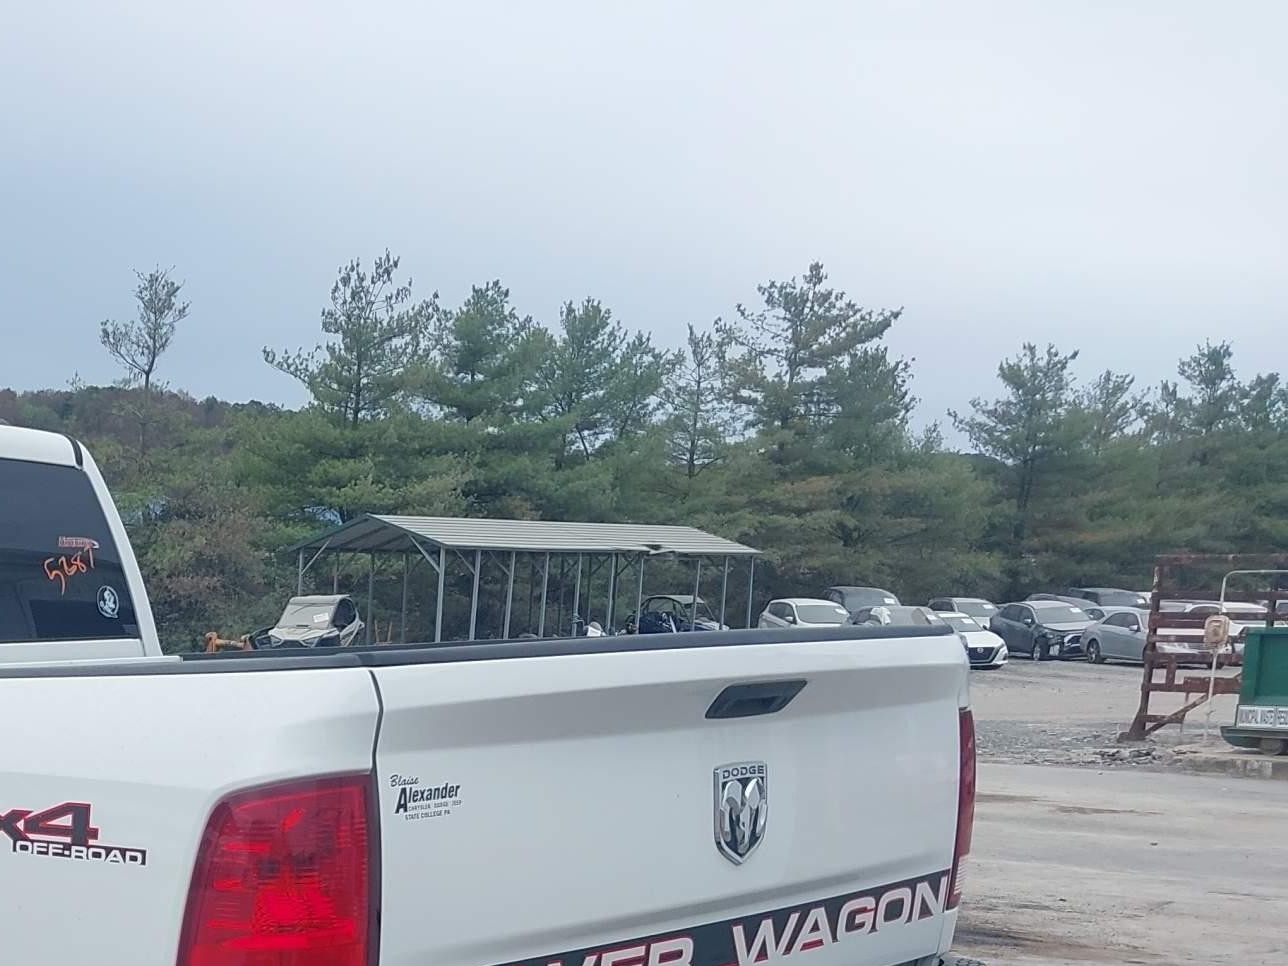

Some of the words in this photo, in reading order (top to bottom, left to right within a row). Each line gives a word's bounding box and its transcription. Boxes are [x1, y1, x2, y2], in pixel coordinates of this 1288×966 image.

[390, 774, 419, 787] Blaise
[722, 765, 764, 779] DODGE
[395, 782, 460, 814] Alexander
[421, 810, 442, 818] COLLEGE
[15, 840, 143, 865] OFF-ROAD
[732, 875, 948, 966] WAGON
